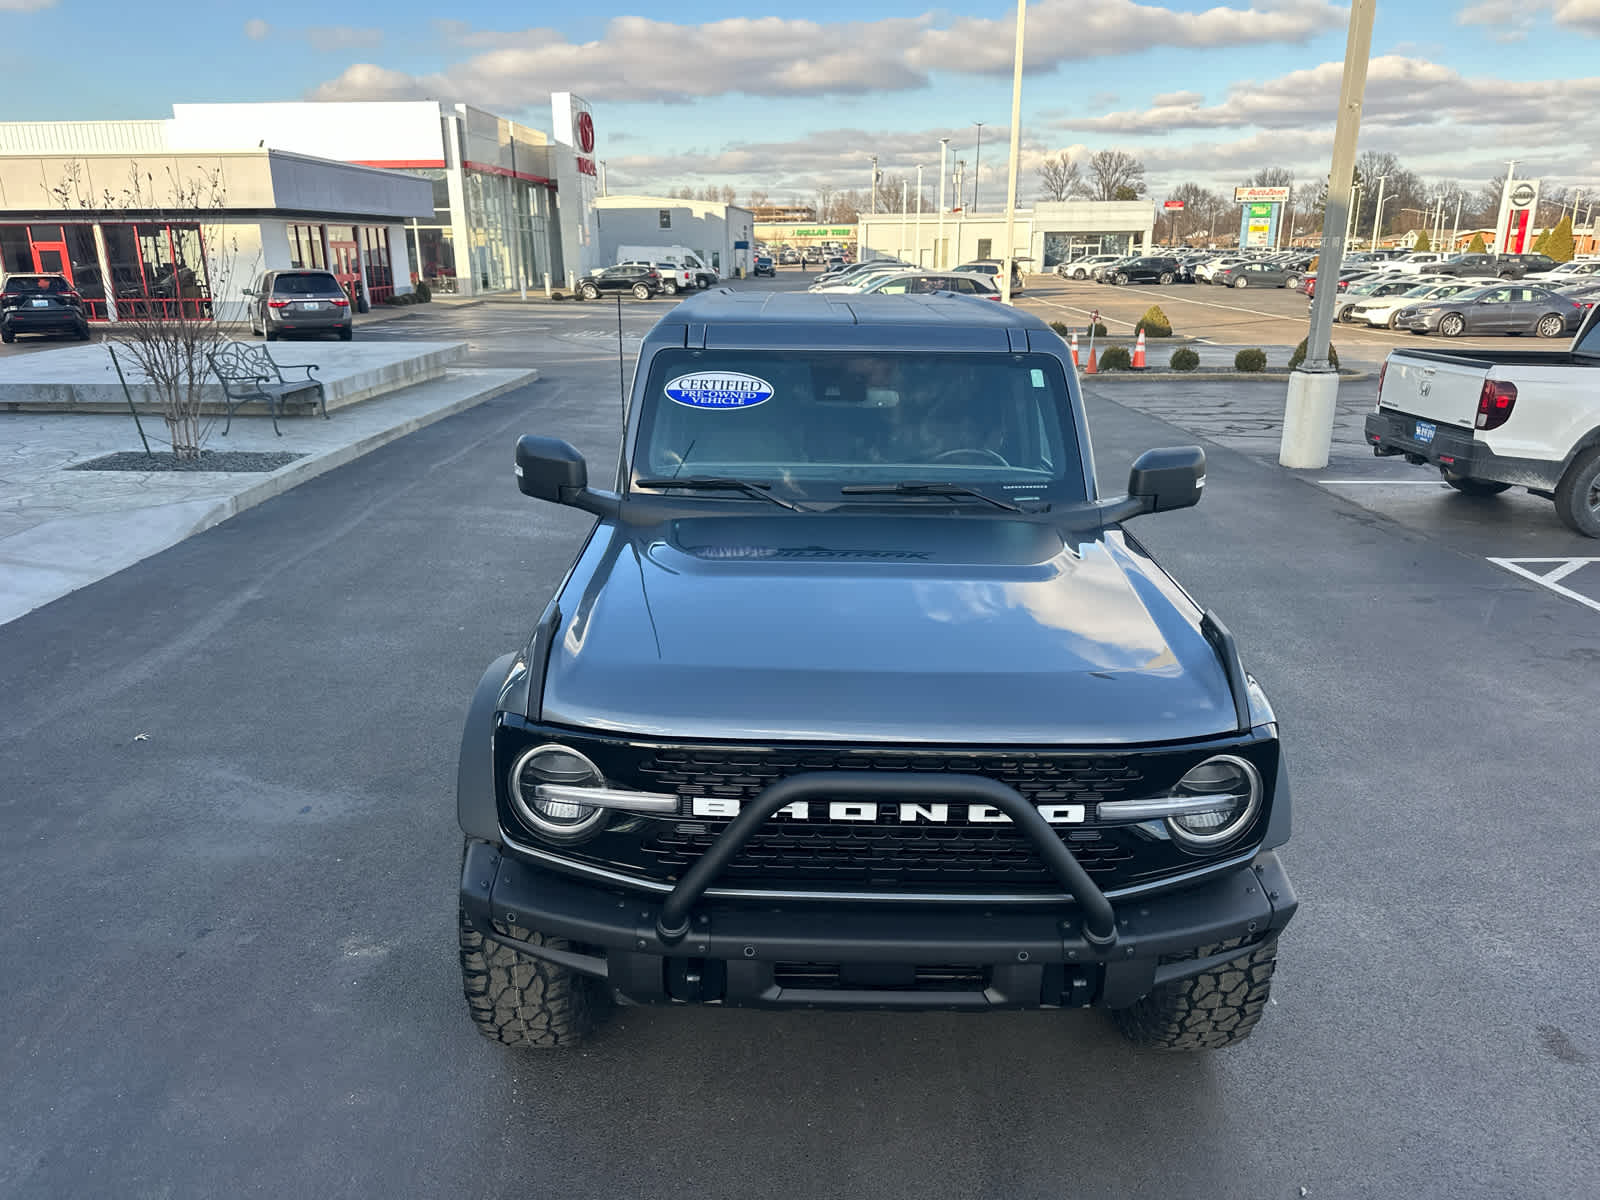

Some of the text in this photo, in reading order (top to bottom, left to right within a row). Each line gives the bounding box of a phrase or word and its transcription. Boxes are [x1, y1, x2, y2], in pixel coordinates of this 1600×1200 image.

[679, 379, 762, 392] CERTIFIED
[681, 390, 757, 399] PRE-OWNED
[692, 396, 745, 405] VEHICLE
